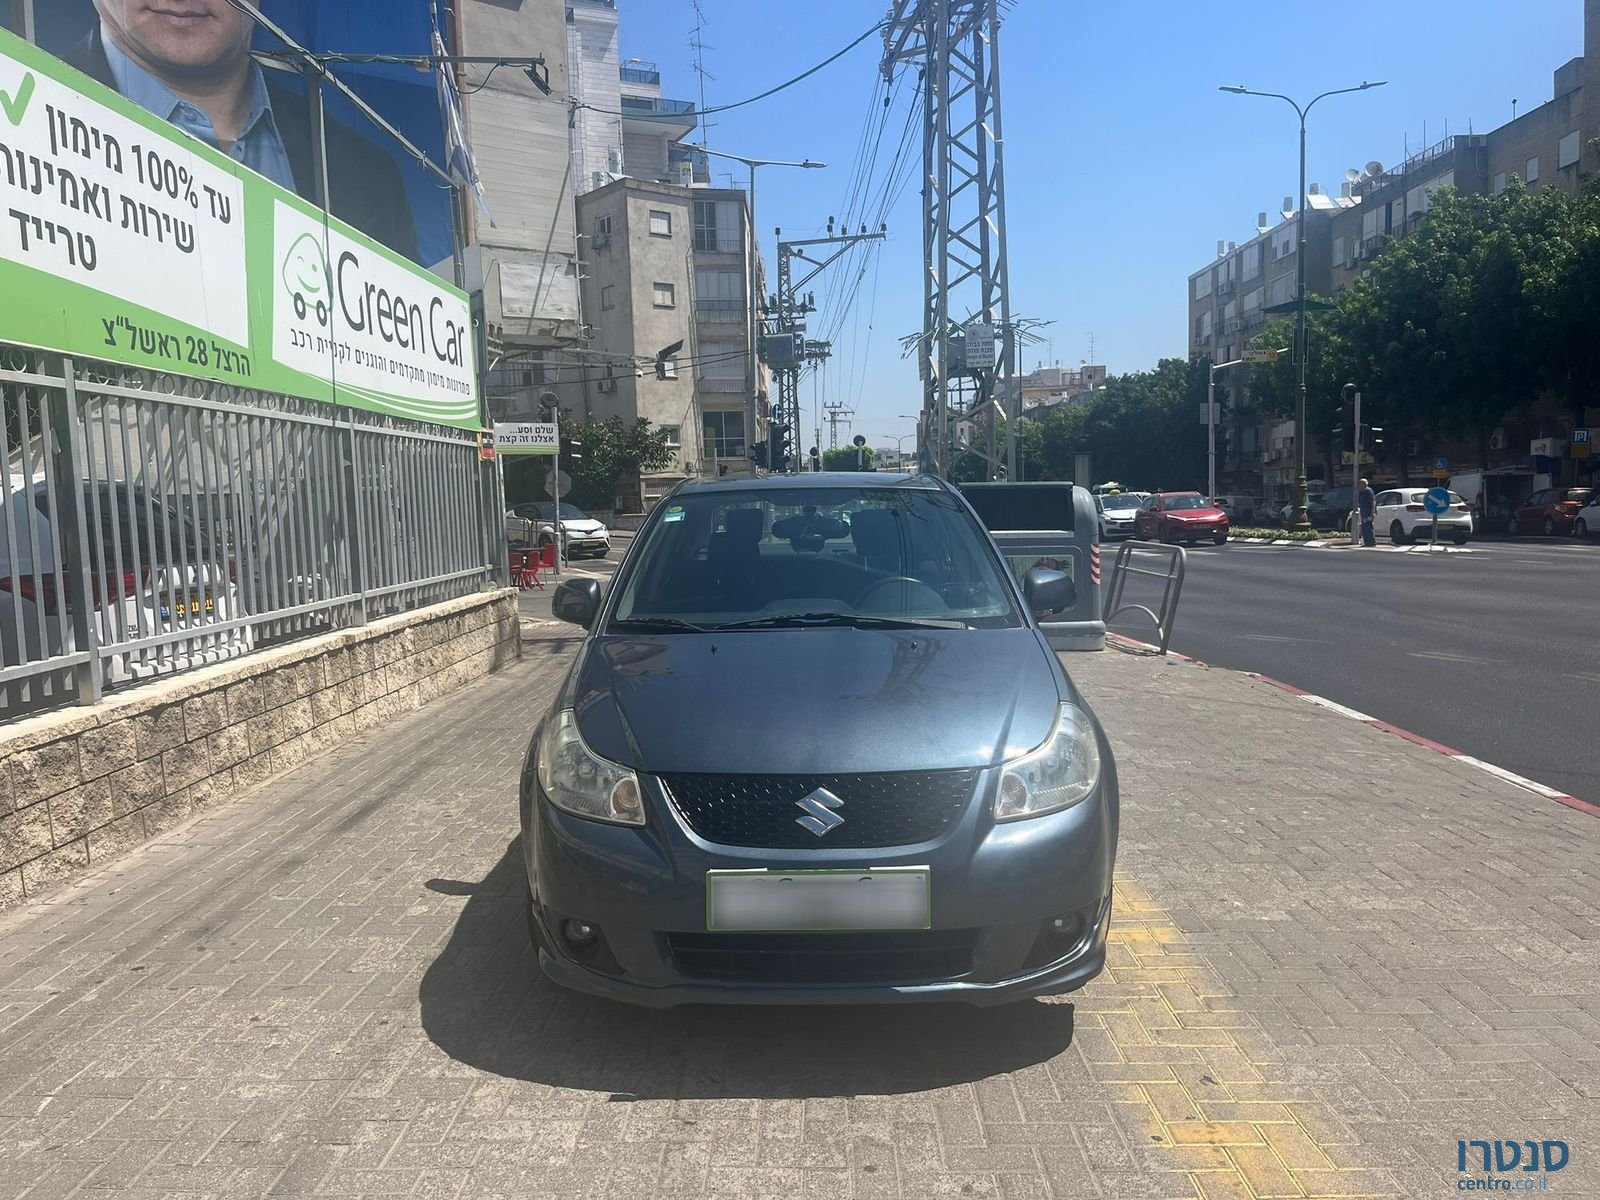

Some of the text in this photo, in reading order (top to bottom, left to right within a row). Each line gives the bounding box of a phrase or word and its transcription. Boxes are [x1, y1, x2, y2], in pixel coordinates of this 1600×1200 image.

[45, 103, 231, 224] עד 100% מימון
[8, 207, 97, 271] טרייד
[120, 194, 195, 254] שירות
[337, 250, 465, 368] Green Car
[185, 335, 208, 367] 28
[290, 328, 313, 351] רכב
[211, 340, 251, 377] הרצל
[355, 349, 387, 372] והוגנים
[390, 360, 425, 383] מתקדמים
[499, 434, 554, 445] אצלנו זה קצת
[510, 425, 554, 434] שלם וסע...
